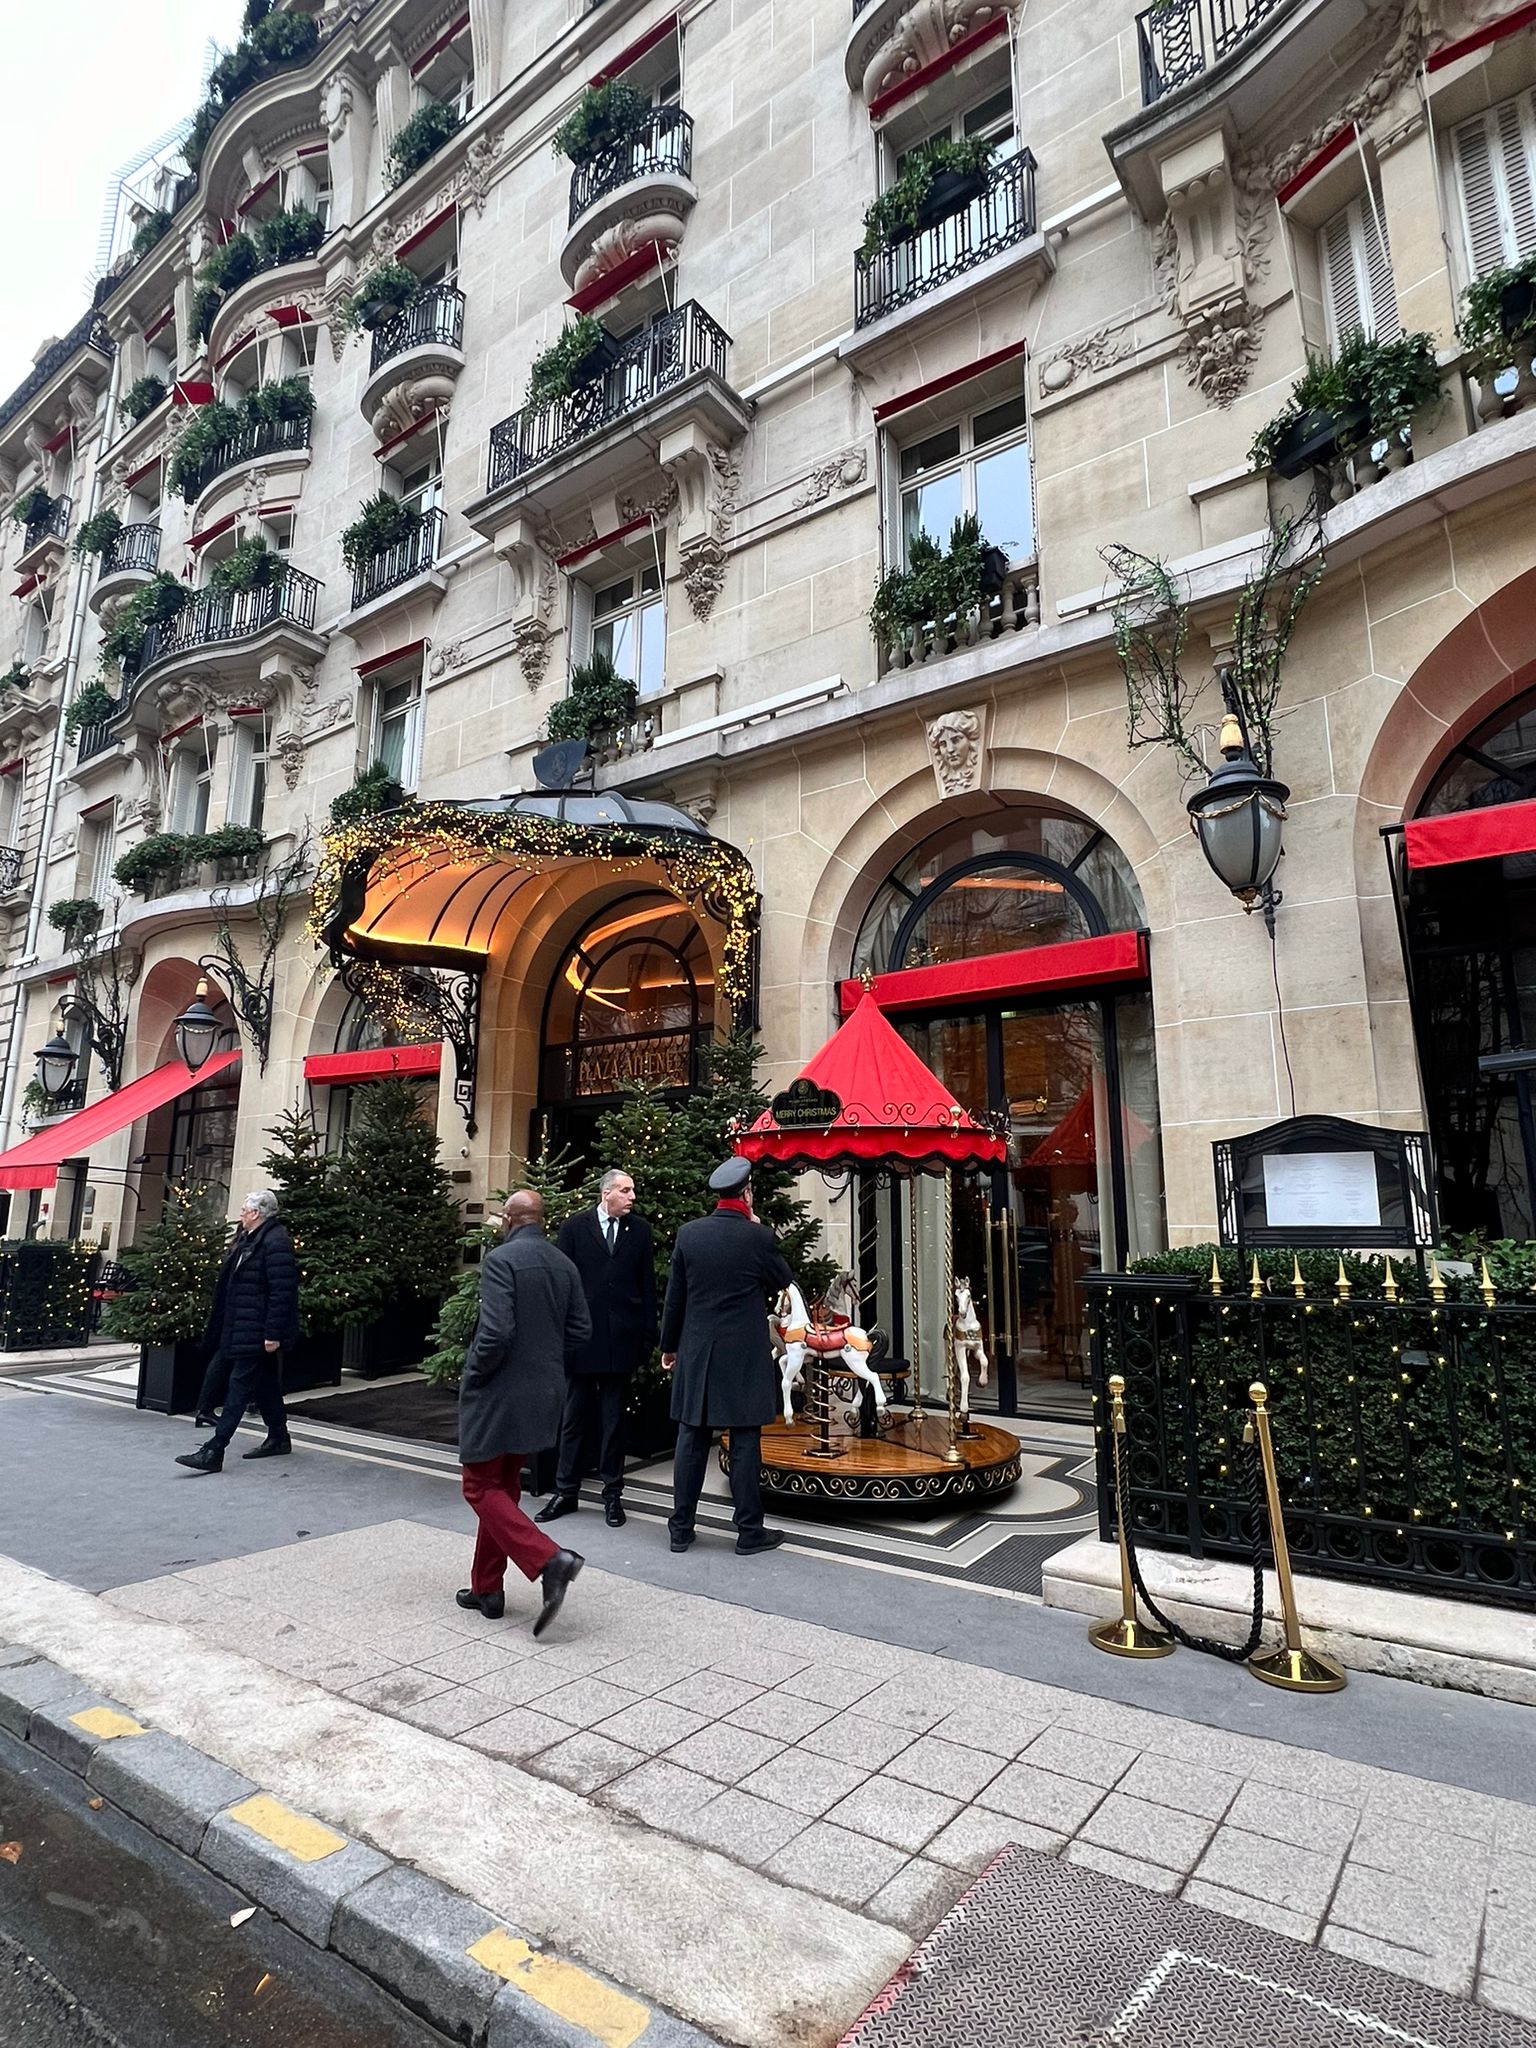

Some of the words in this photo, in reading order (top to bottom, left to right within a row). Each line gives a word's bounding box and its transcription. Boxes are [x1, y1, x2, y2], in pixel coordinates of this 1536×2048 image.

[579, 1057, 619, 1081] PLAZA
[775, 1109, 797, 1119] MERRY
[797, 1106, 837, 1118] CHRISTMAS
